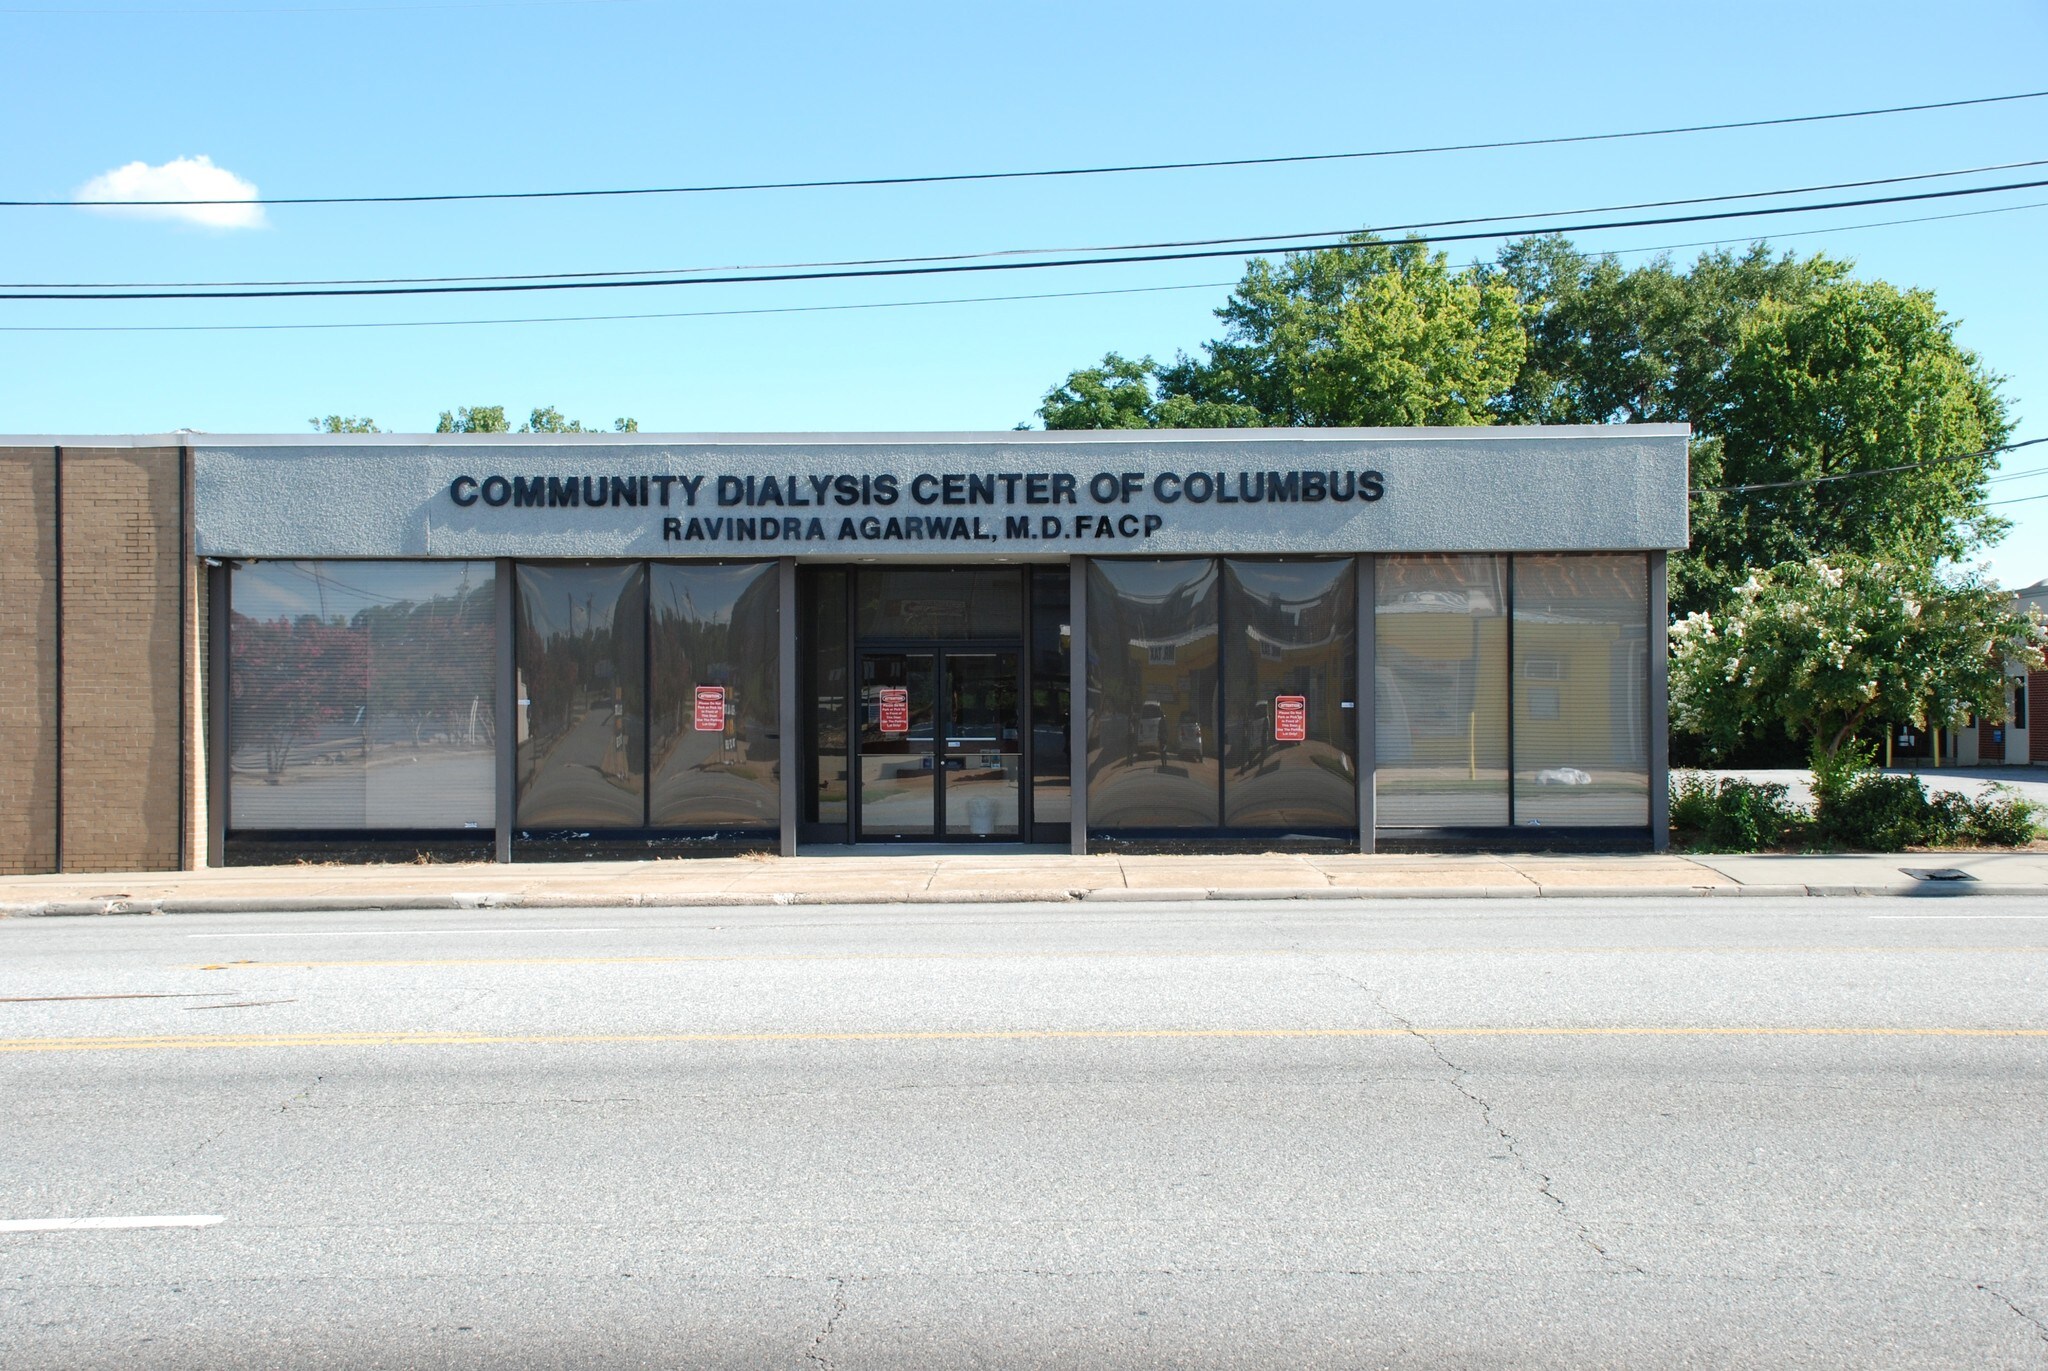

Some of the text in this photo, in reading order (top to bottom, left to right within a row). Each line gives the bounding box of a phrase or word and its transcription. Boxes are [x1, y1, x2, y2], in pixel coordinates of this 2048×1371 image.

[451, 470, 1386, 508] COMMUNITY DIALYSIS CENTER OF COLUMBUS
[663, 517, 826, 542] RAVINDRA
[837, 516, 998, 543] AGARWAL,
